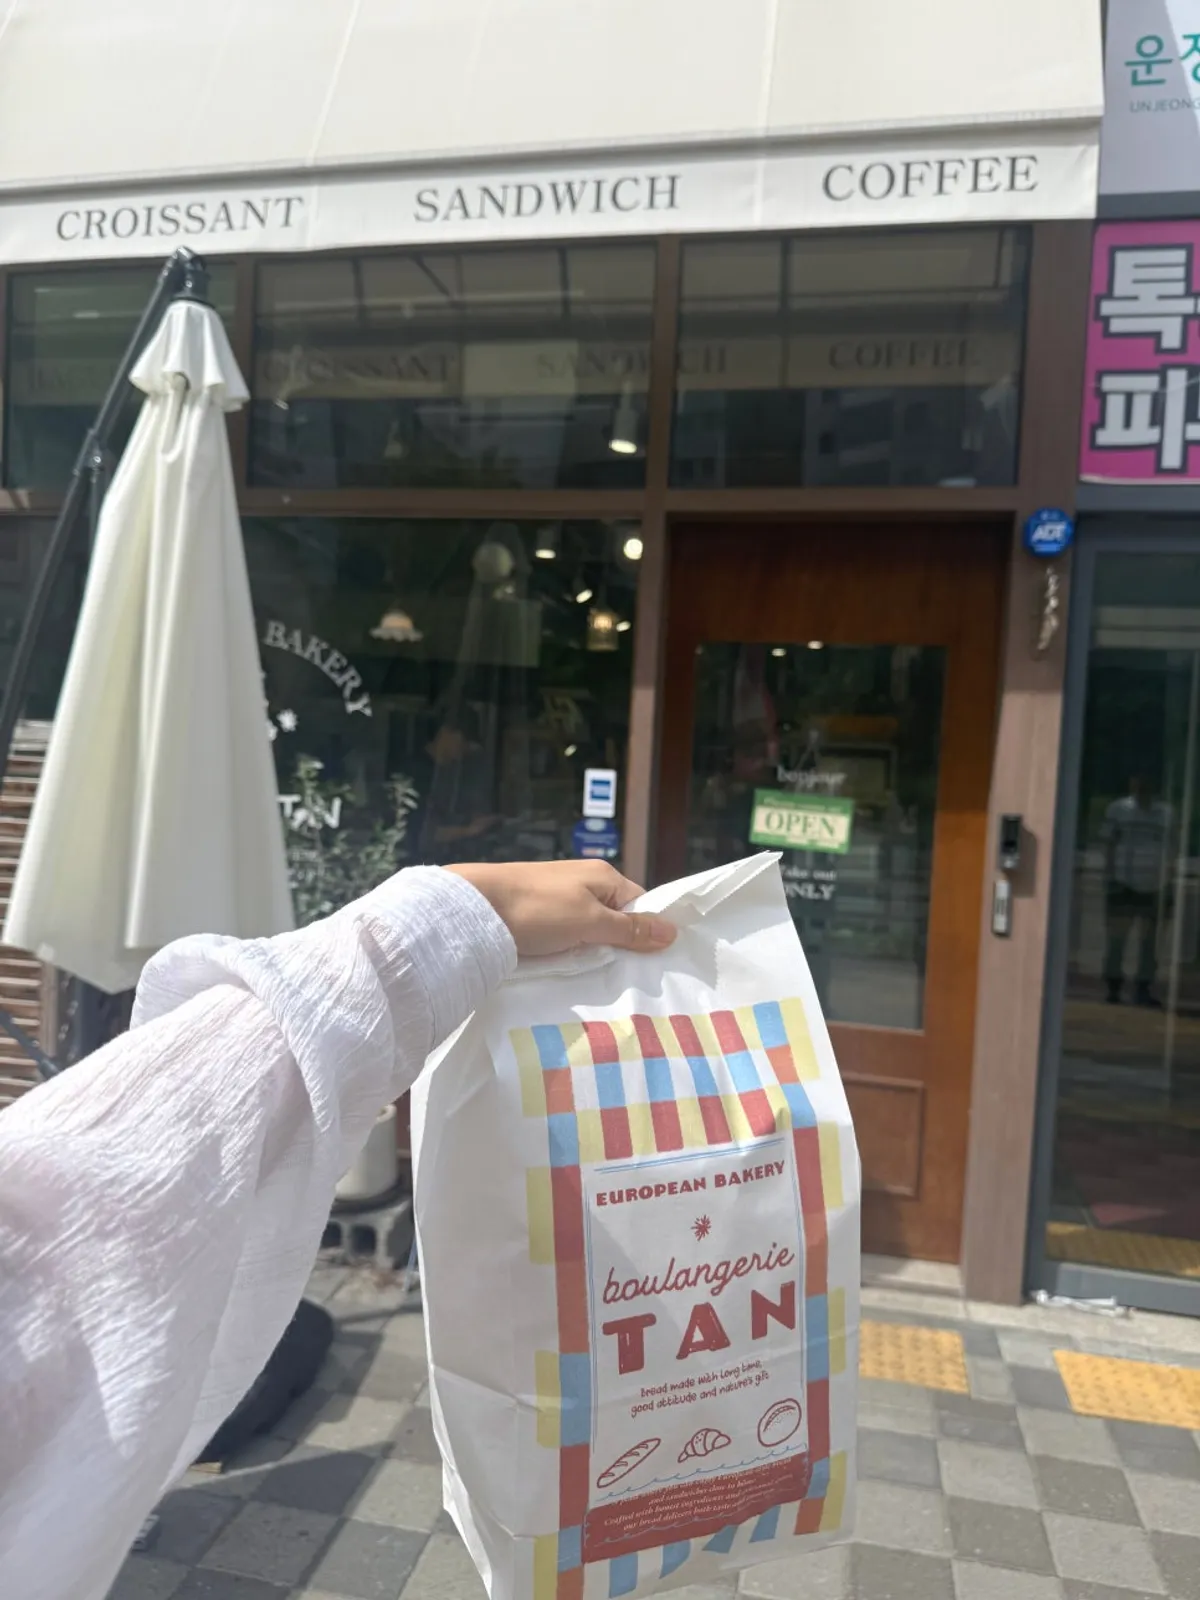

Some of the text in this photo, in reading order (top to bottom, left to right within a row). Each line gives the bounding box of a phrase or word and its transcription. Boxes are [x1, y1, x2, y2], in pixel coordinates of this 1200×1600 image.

[57, 154, 1038, 241] CROISSANT SANDWICH COFFEE
[1095, 244, 1200, 353] 톡
[1090, 364, 1200, 474] 피
[262, 619, 373, 718] BAKERY
[764, 809, 838, 838] OPEN
[596, 1160, 785, 1207] EUROPEAN BAKERY
[602, 1242, 795, 1305] boulangerie
[602, 1280, 796, 1375] TAN
[631, 1400, 655, 1419] good
[699, 1386, 717, 1400] and
[670, 1377, 695, 1391] made
